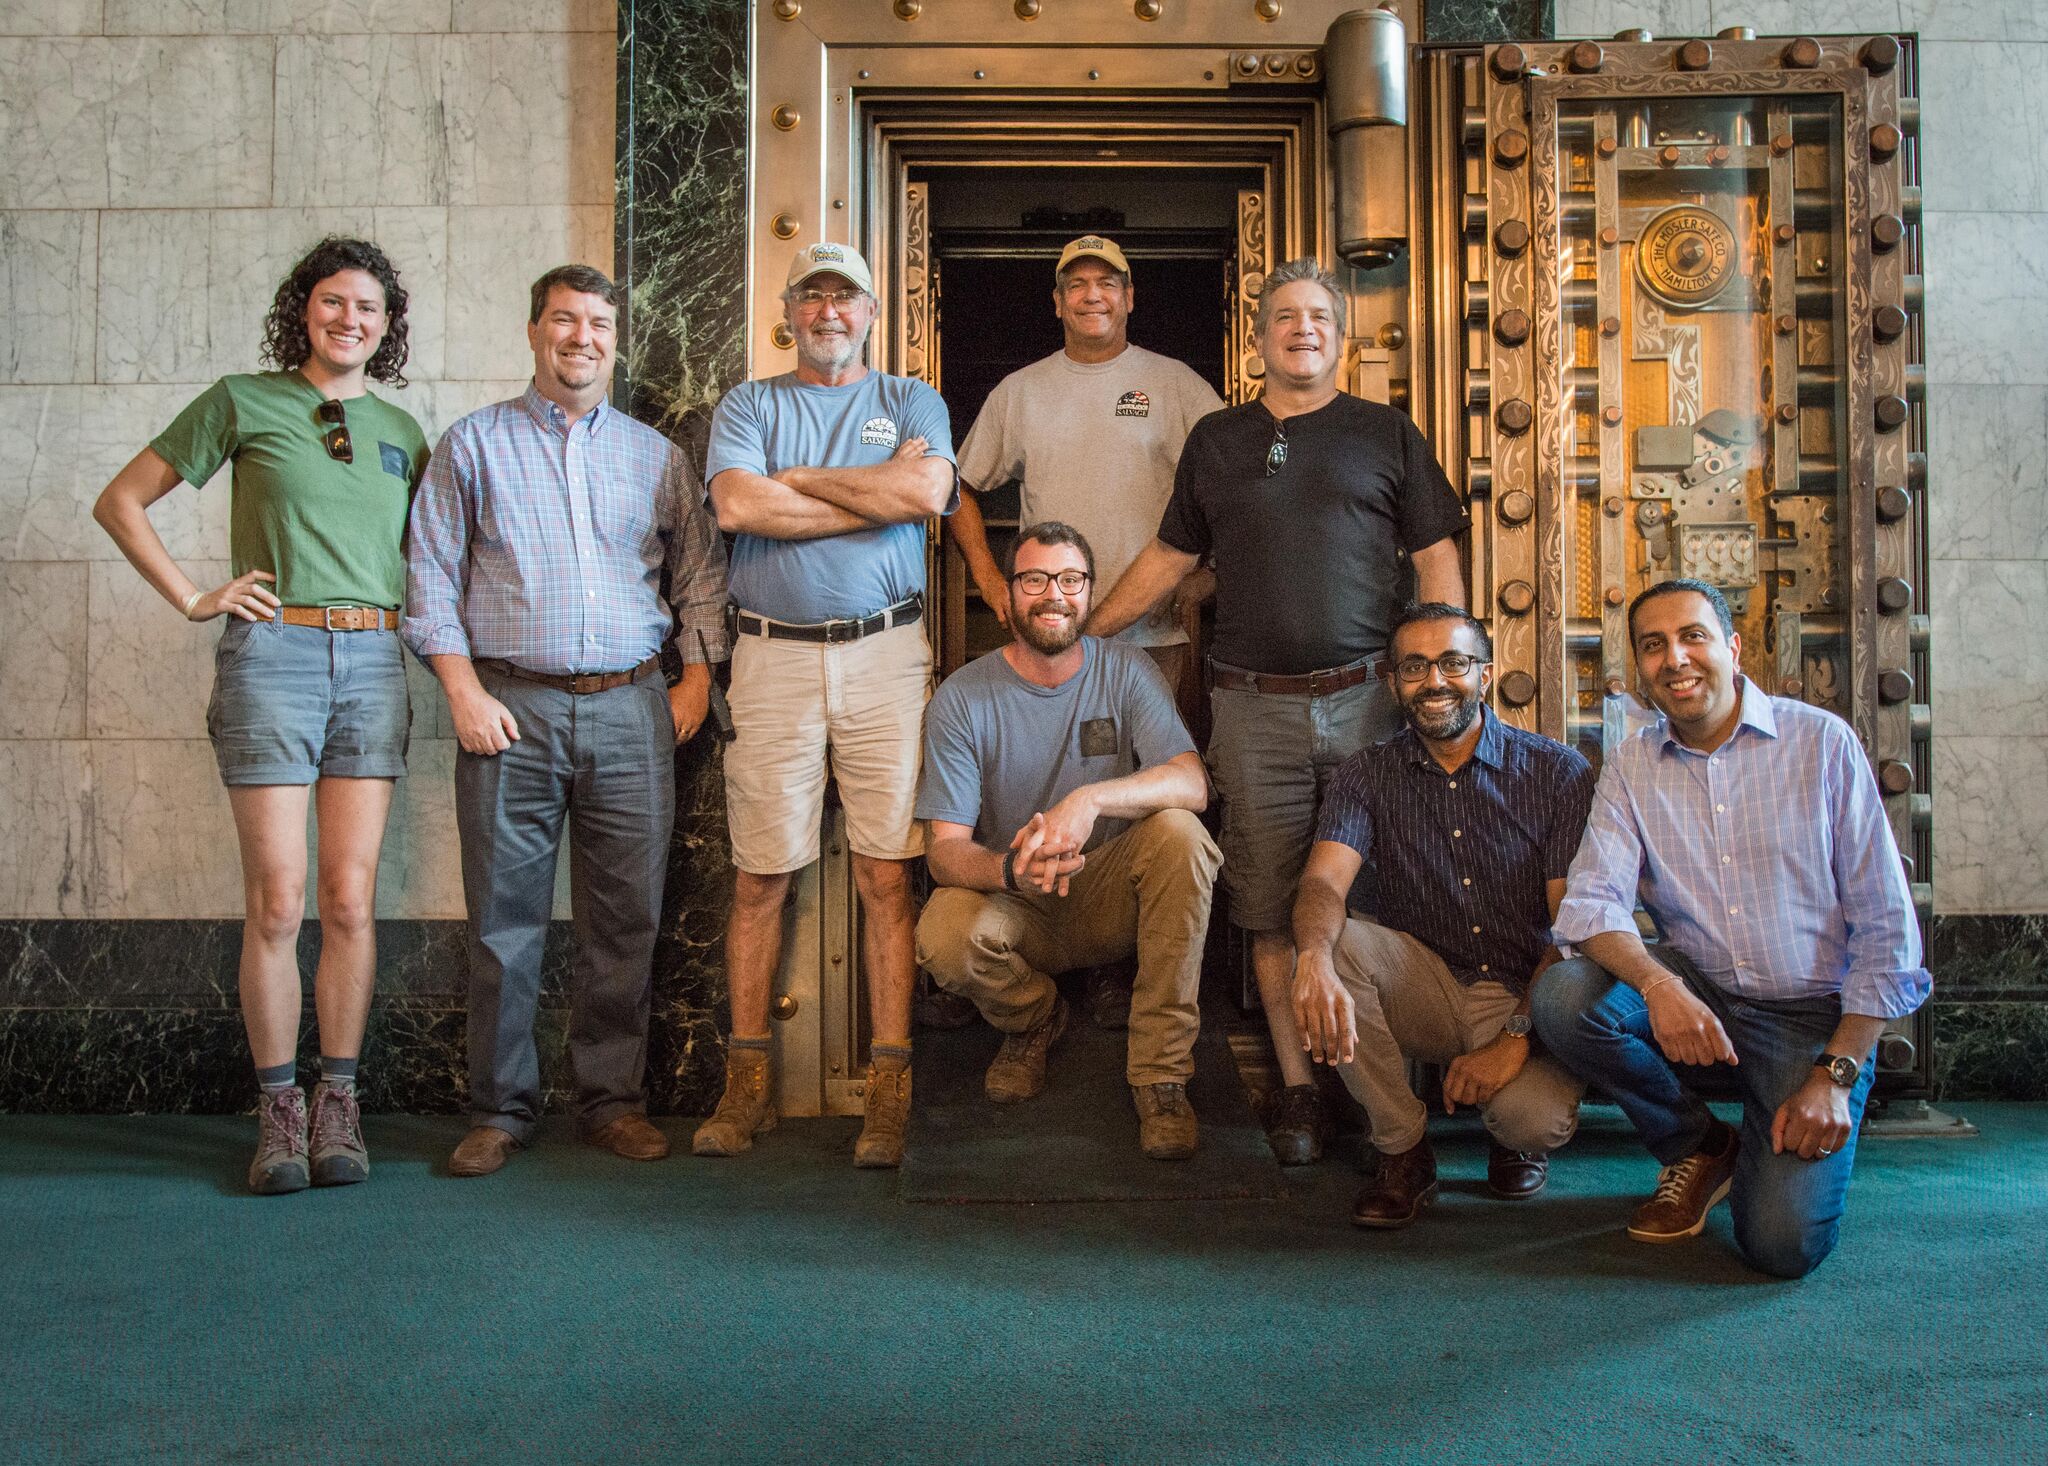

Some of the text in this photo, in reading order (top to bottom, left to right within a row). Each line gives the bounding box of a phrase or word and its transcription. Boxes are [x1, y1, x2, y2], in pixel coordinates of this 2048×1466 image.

[1654, 241, 1666, 261] THE
[1660, 218, 1698, 242] MOSLER
[1699, 221, 1722, 242] SAFE
[861, 436, 896, 449] SALVAGE
